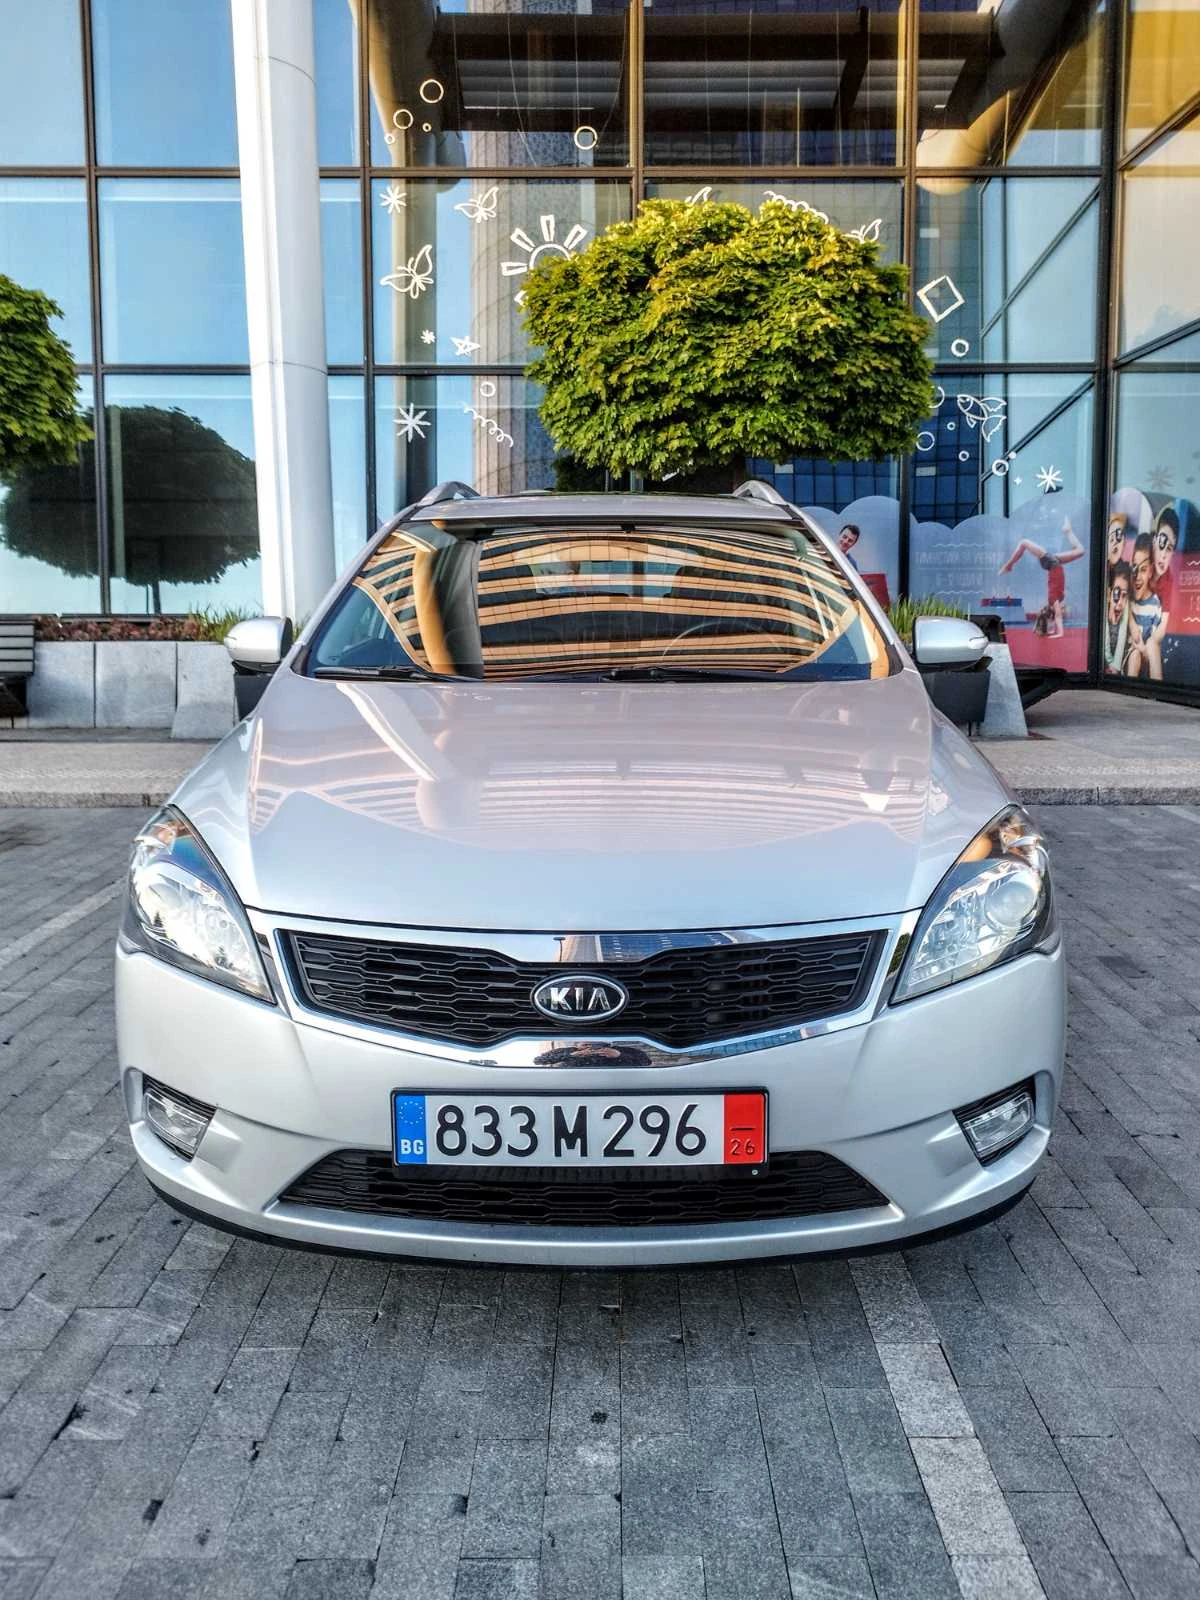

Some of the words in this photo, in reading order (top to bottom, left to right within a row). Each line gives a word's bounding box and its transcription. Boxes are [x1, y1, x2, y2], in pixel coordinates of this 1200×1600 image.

[550, 987, 612, 1011] KIA
[435, 1104, 538, 1157] 833
[552, 1105, 588, 1157] M
[602, 1104, 706, 1157] 296
[401, 1139, 425, 1155] BG
[730, 1138, 756, 1156] 26
